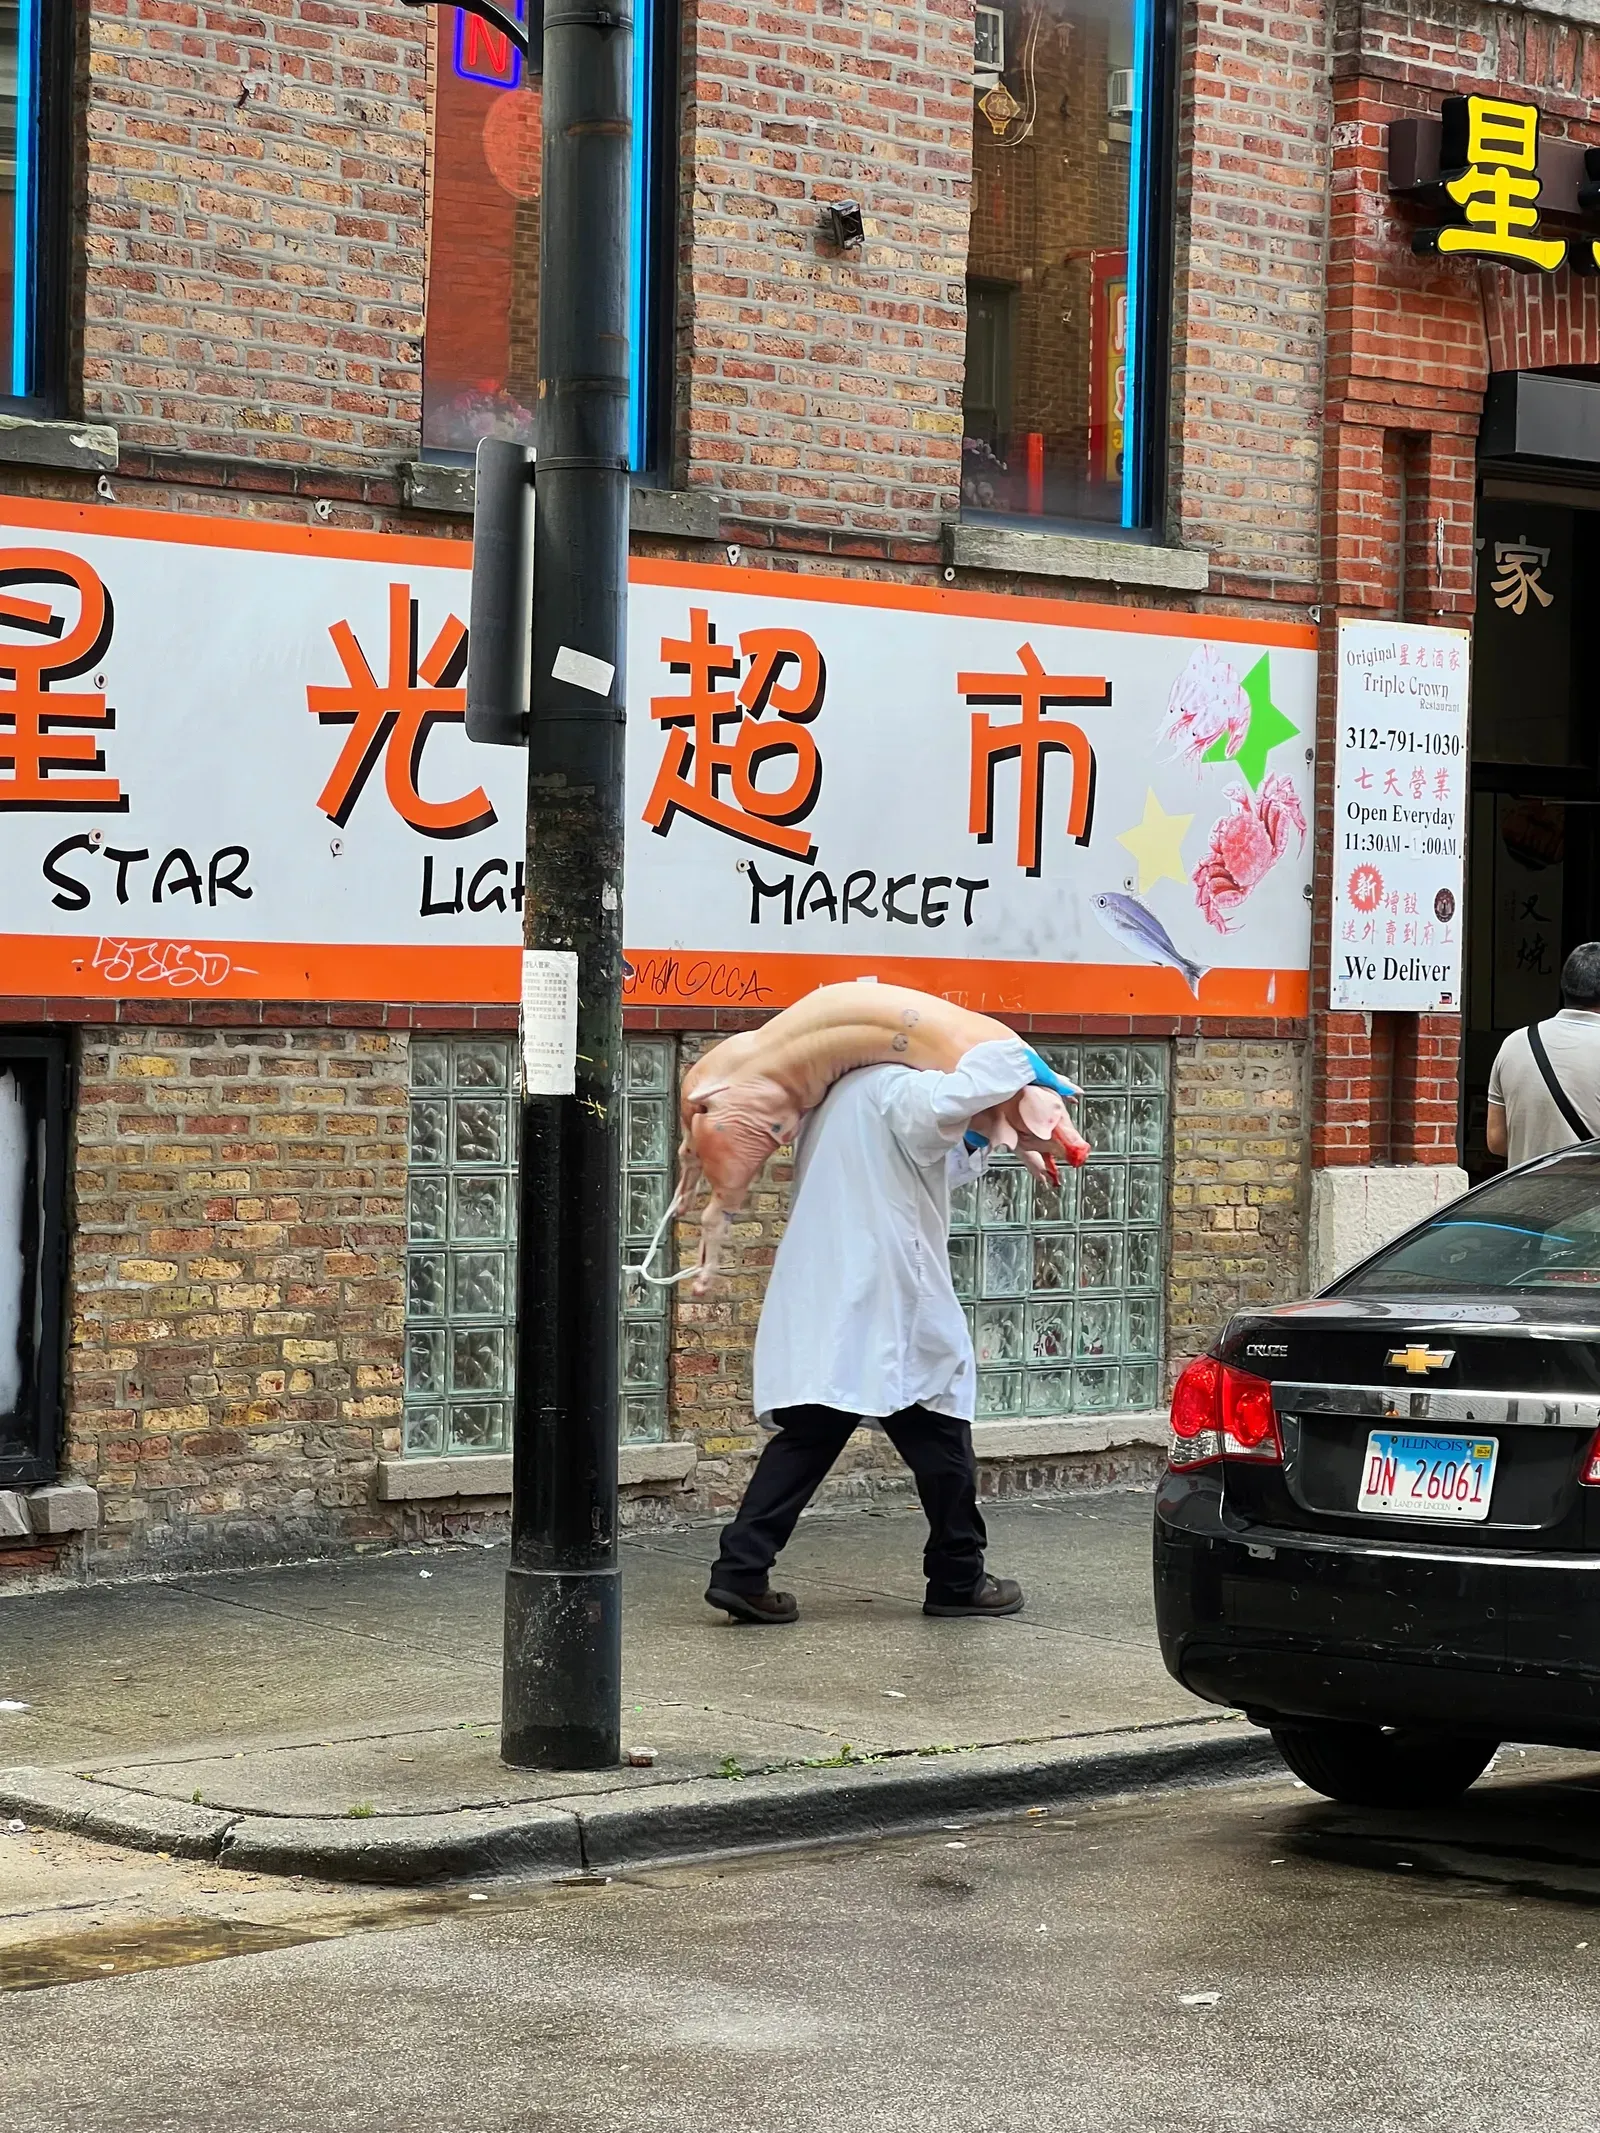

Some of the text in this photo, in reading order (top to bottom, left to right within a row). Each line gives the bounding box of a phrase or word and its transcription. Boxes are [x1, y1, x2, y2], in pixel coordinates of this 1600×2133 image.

[1437, 95, 1600, 272] 星
[1476, 534, 1555, 616] 家
[1346, 643, 1461, 671] Original 星光酒家
[1363, 672, 1449, 700] Triple Crown
[1419, 698, 1460, 713] Restaurant
[1345, 726, 1460, 757] 312-791-1030
[1354, 765, 1451, 801] 七天營業
[1347, 801, 1456, 830] Open Everyday
[1345, 832, 1400, 852] 11:30AM
[42, 832, 254, 911] STAR
[746, 859, 990, 928] MARKET
[1354, 872, 1377, 904] 新
[1342, 919, 1454, 947] 送外賣到府上
[1345, 955, 1451, 982] We Deliver
[1246, 1344, 1289, 1357] CRUZE
[1401, 1438, 1463, 1452] ILLINOIS
[1366, 1456, 1484, 1503] DN 26061
